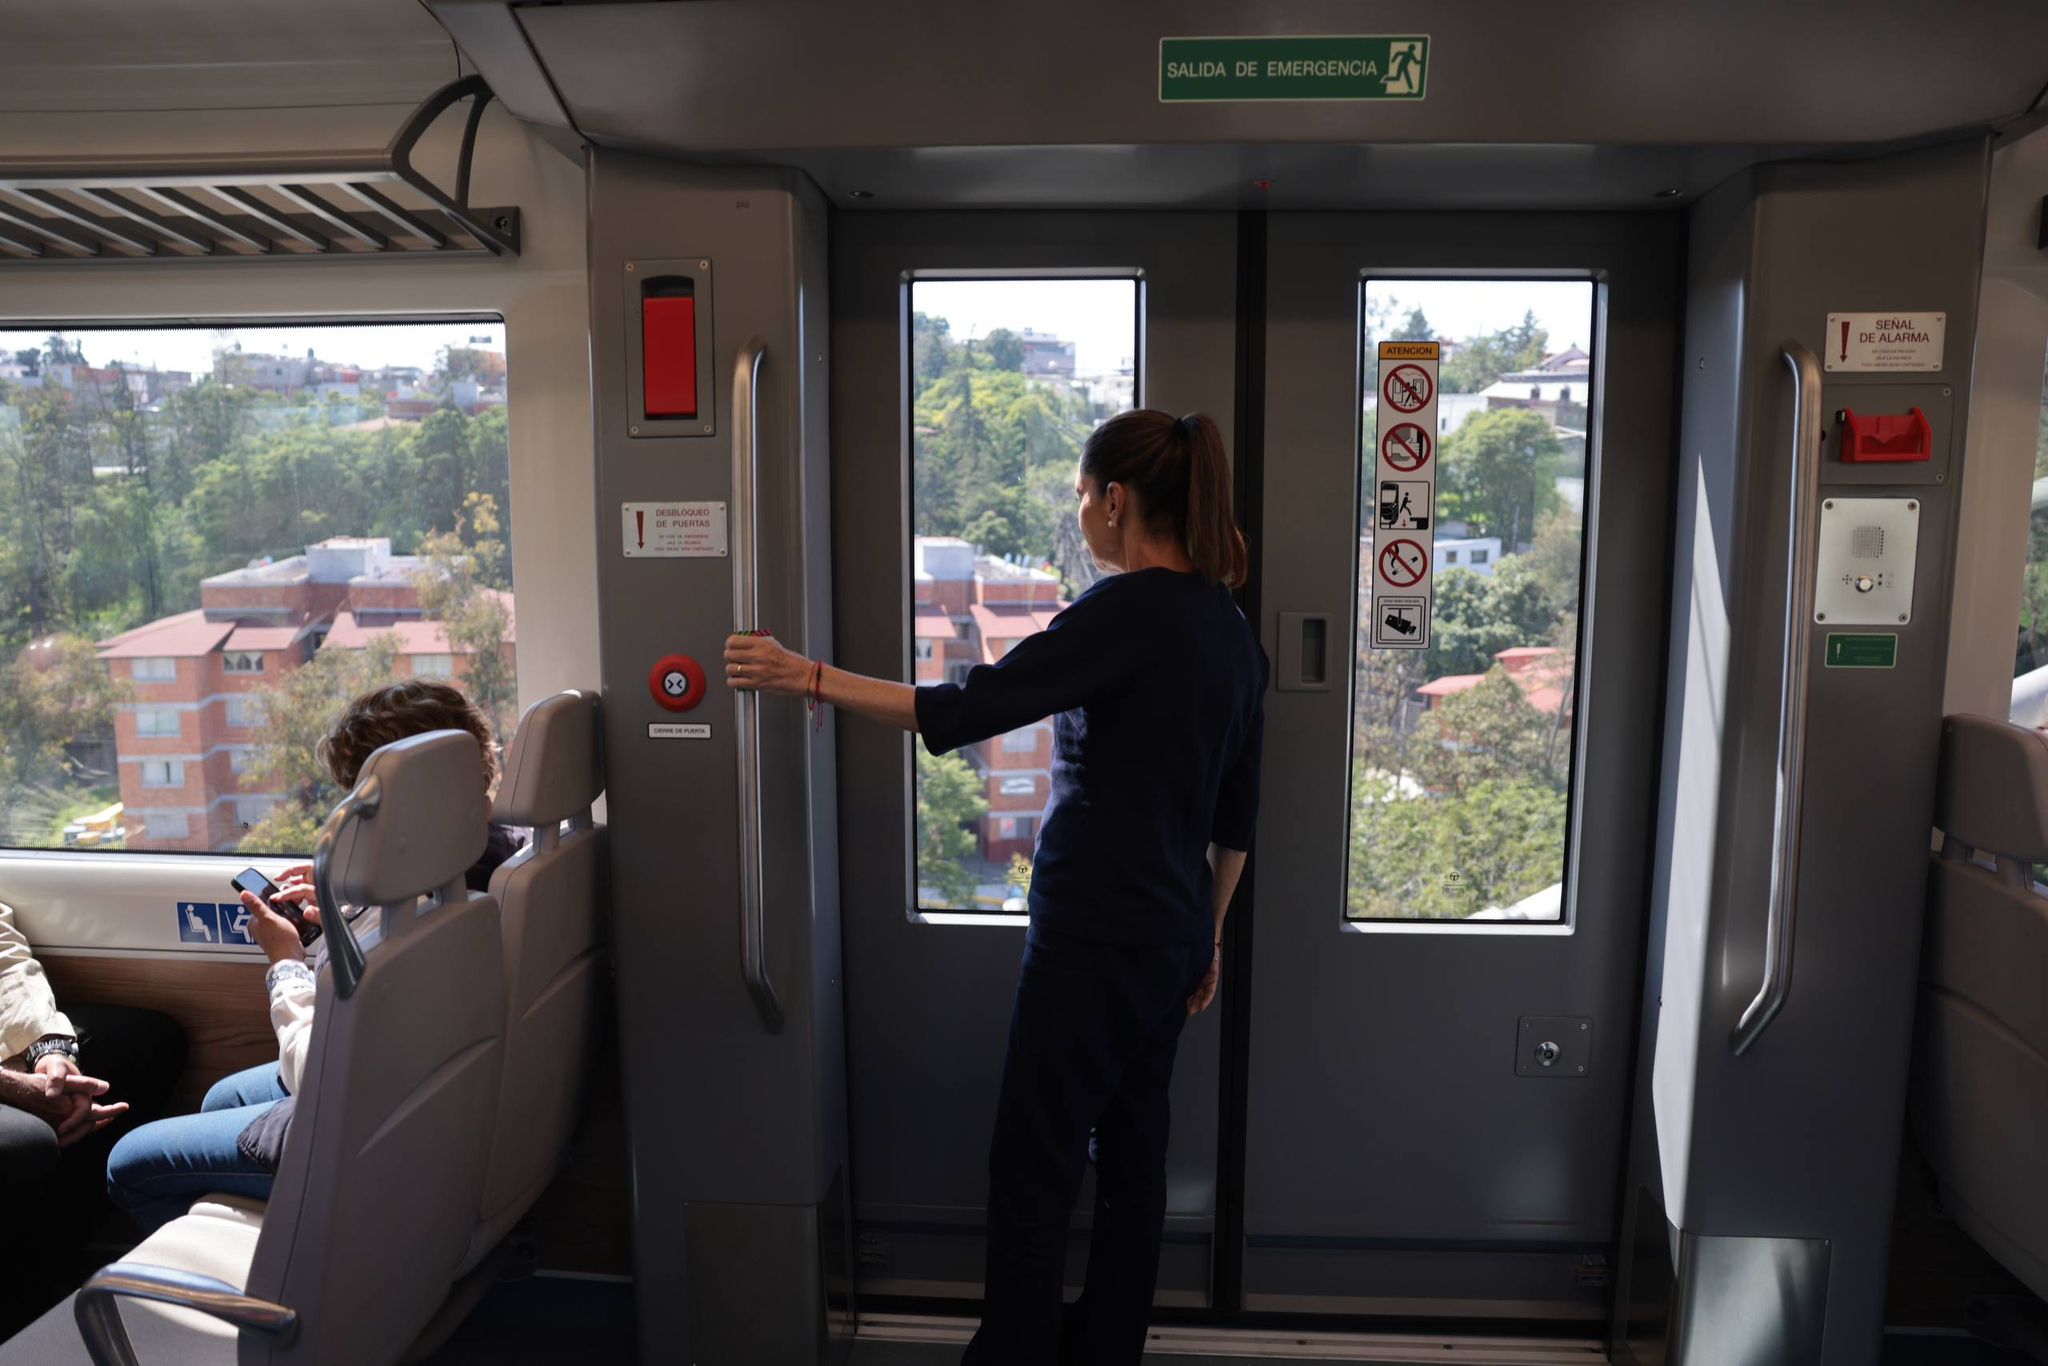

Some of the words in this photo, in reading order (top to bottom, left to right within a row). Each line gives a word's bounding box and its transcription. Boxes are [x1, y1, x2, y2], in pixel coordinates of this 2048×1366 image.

[1167, 62, 1227, 78] SALIDA
[1235, 61, 1258, 77] DE
[1267, 60, 1378, 77] EMERGENCIA
[1859, 333, 1876, 343] DE
[1878, 332, 1930, 343] ALARMA
[1387, 346, 1432, 355] ATENCION
[655, 508, 710, 517] DESBLOQUEO
[656, 519, 668, 528] DE
[672, 519, 710, 528] PUERTAS
